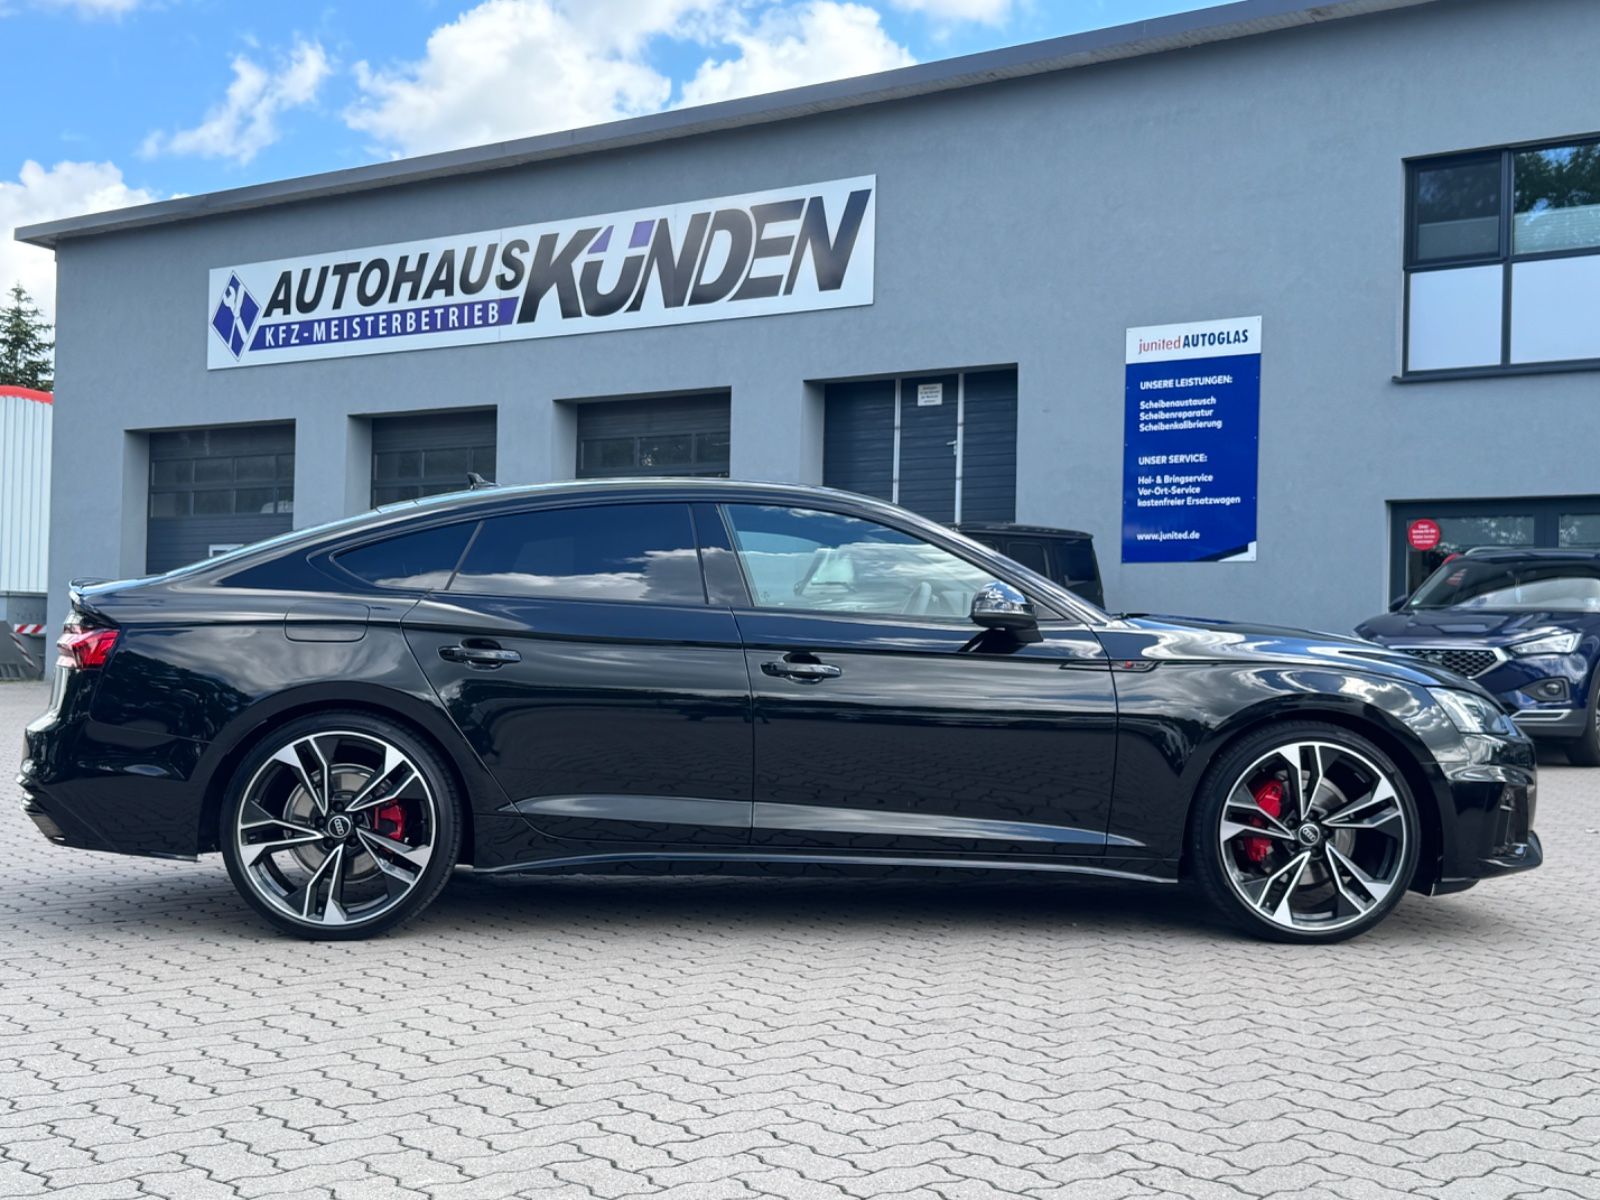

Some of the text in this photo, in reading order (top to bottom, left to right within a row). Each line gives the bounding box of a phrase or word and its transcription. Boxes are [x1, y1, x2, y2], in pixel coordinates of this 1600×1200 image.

[516, 189, 872, 324] KÜNDEN
[263, 239, 530, 318] AUTOHAUS
[265, 302, 499, 347] KFZ-MEISTERBETRIEB
[1140, 375, 1233, 390] UNSERE LEISTUNGEN:
[1139, 396, 1217, 410] Scheibenaustausch
[1139, 408, 1214, 421] Scheibenreparatur
[1139, 419, 1223, 432] Scheibenkalibrierung
[1138, 453, 1208, 465] UNSER SERVICE:
[1155, 476, 1162, 484] &
[1163, 473, 1214, 485] Bringservice
[1137, 485, 1201, 496] Vor-Ort-Service
[1137, 496, 1241, 507] kostenfreier Ersatzwagen
[1137, 530, 1200, 542] www.junited.de
